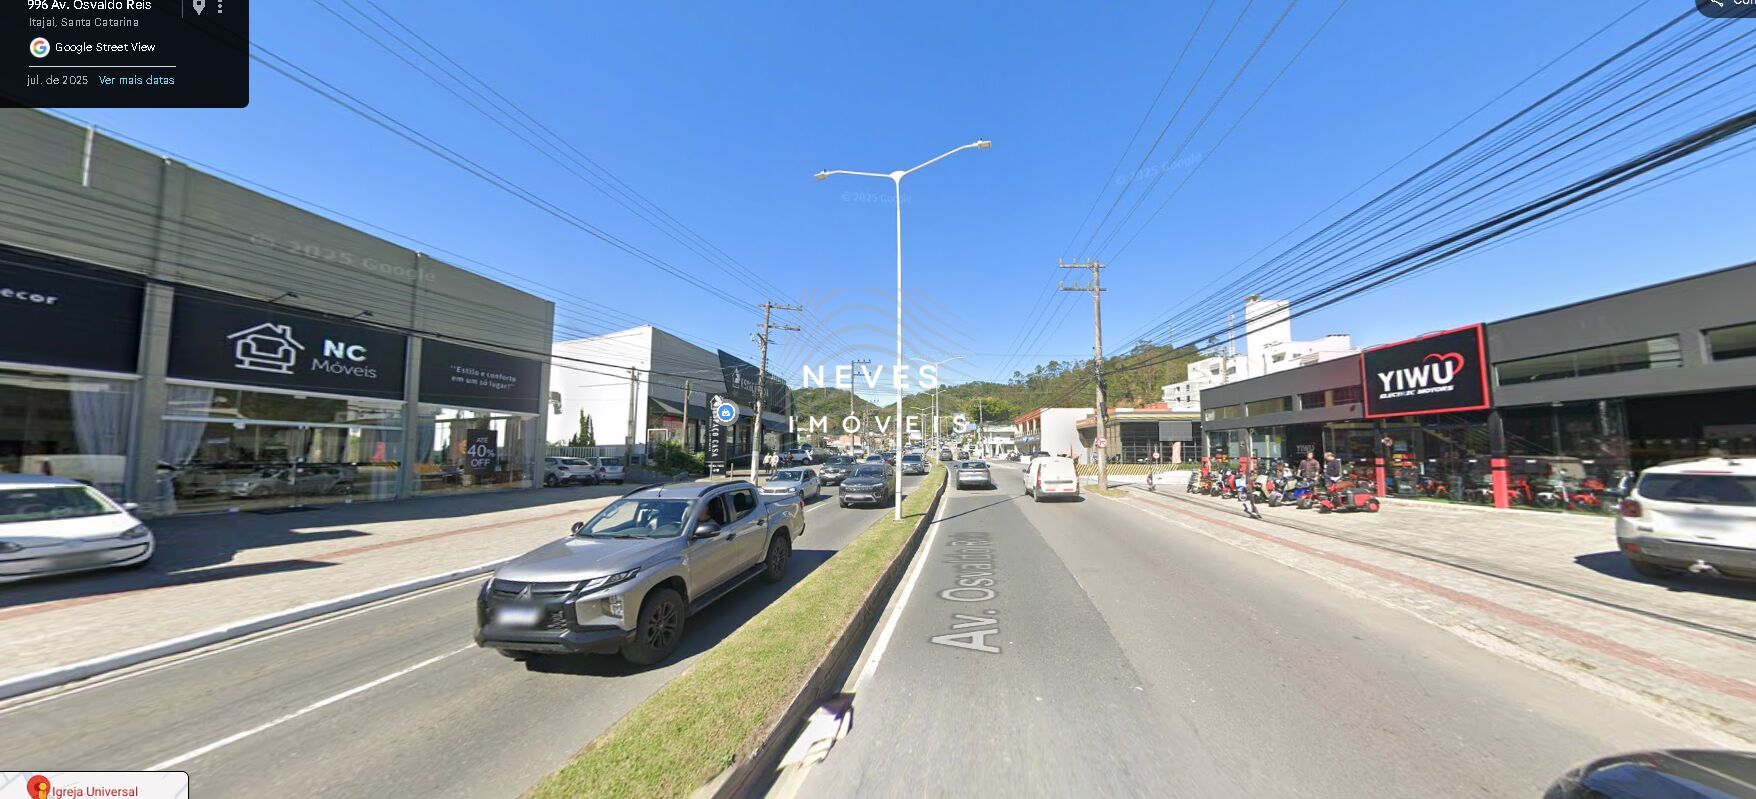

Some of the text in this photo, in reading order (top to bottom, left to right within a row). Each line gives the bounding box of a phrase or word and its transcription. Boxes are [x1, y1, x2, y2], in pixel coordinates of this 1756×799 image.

[323, 339, 367, 361] NC
[311, 358, 378, 379] Móveis
[1377, 360, 1454, 392] YIWU
[1417, 384, 1455, 395] MOTORS
[467, 444, 496, 458] 40%
[711, 439, 719, 457] CASA
[470, 458, 490, 468] OFF
